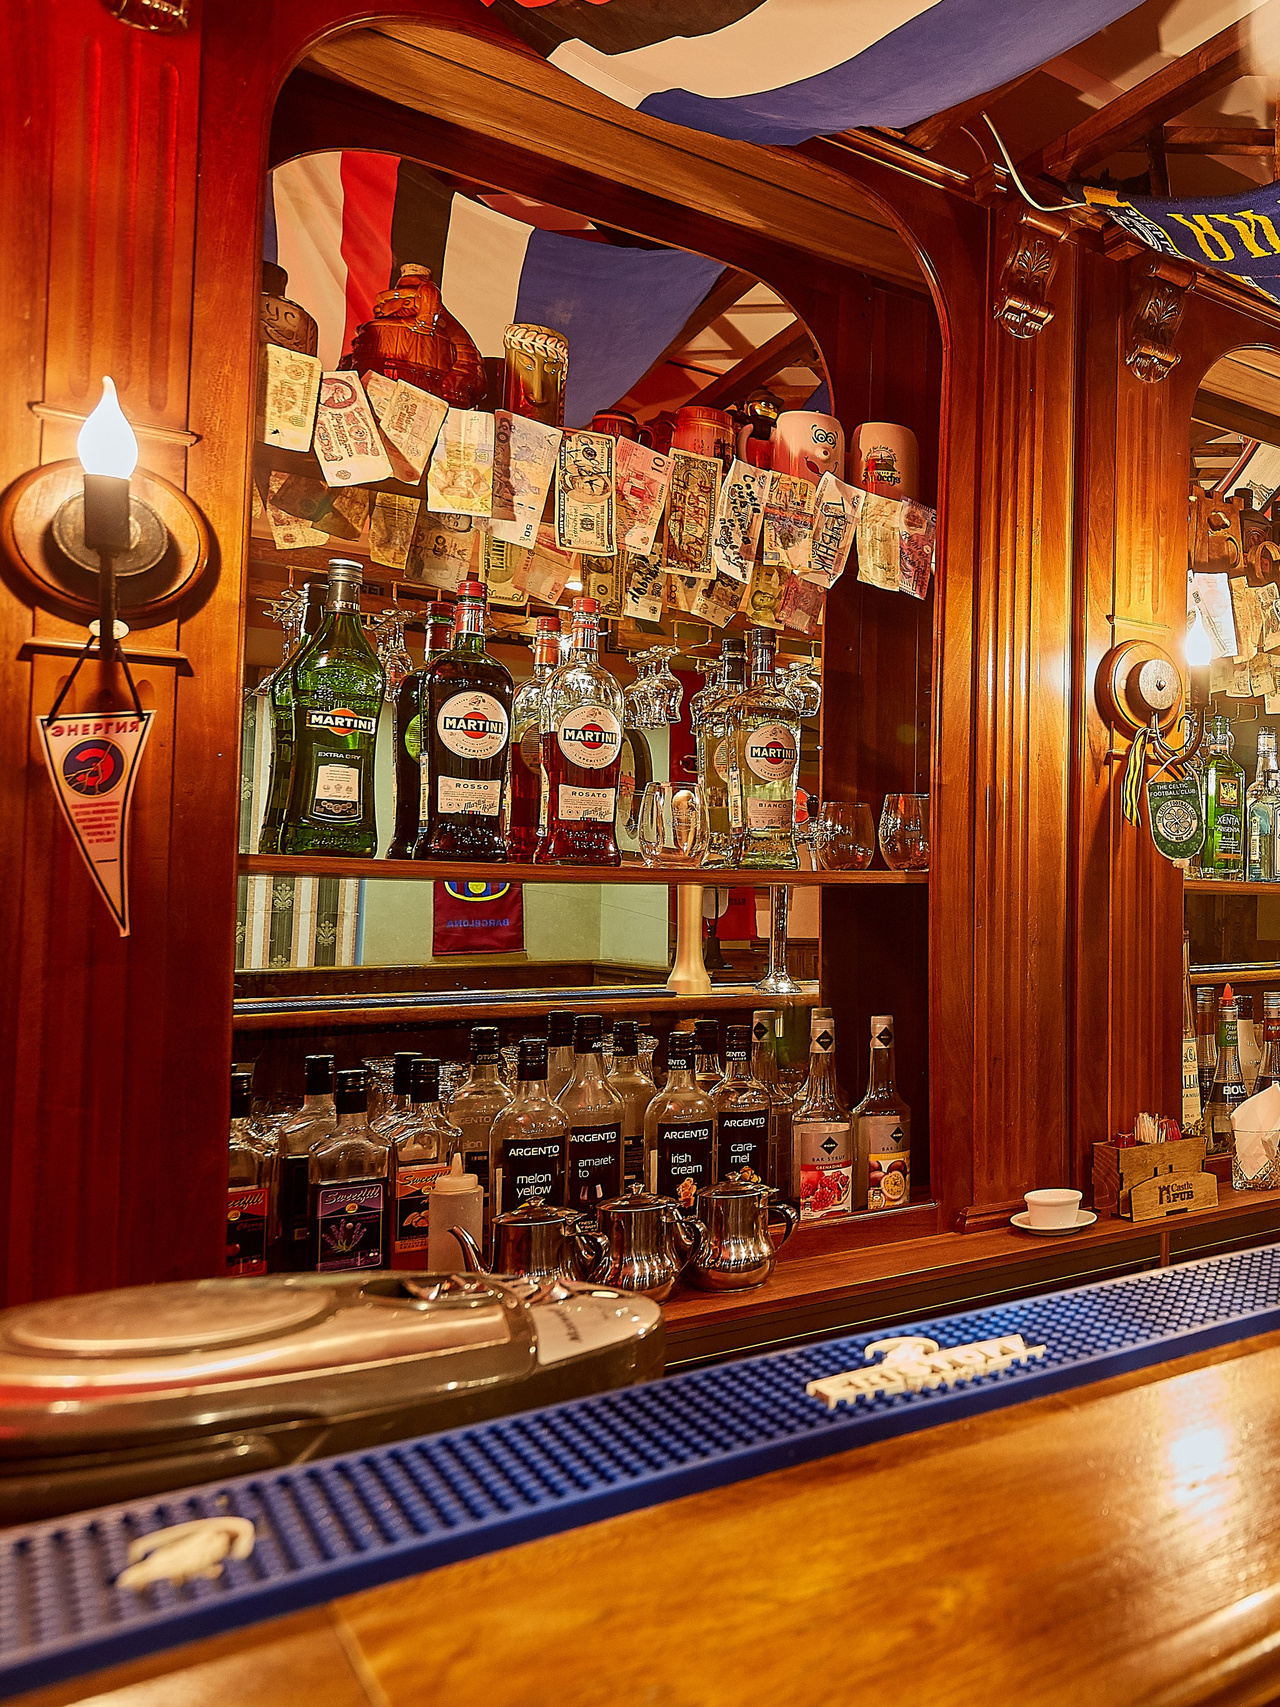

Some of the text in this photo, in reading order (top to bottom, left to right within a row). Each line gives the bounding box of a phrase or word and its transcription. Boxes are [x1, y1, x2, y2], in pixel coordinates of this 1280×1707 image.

[311, 714, 373, 731] MARTINI
[445, 718, 503, 733] MARTINI
[51, 721, 141, 738] ЭНЕРГИЯ
[565, 730, 617, 744] MARTINI
[318, 751, 362, 761] EXTRA DRY
[752, 747, 795, 760] MARTINI
[571, 791, 608, 799] ROSATO
[1150, 789, 1180, 798] FOOTBALL
[758, 802, 787, 810] BIANCO
[1216, 814, 1240, 826] XENTA
[1223, 1085, 1246, 1096] BOLS
[724, 1116, 766, 1129] ARGENTO
[571, 1131, 617, 1143] ARGENTO
[664, 1128, 709, 1140] ARGENTO
[509, 1145, 560, 1157] ARGENTO
[730, 1143, 757, 1153] cara-
[578, 1155, 615, 1168] amaret-
[671, 1152, 692, 1164] irish
[730, 1153, 750, 1164] mel
[671, 1163, 703, 1175] cream
[816, 1163, 843, 1171] GRENADINE
[516, 1171, 552, 1184] melon
[578, 1168, 590, 1179] to
[516, 1184, 552, 1198] yellow
[1171, 1181, 1193, 1192] Castle
[1172, 1190, 1194, 1203] PUB
